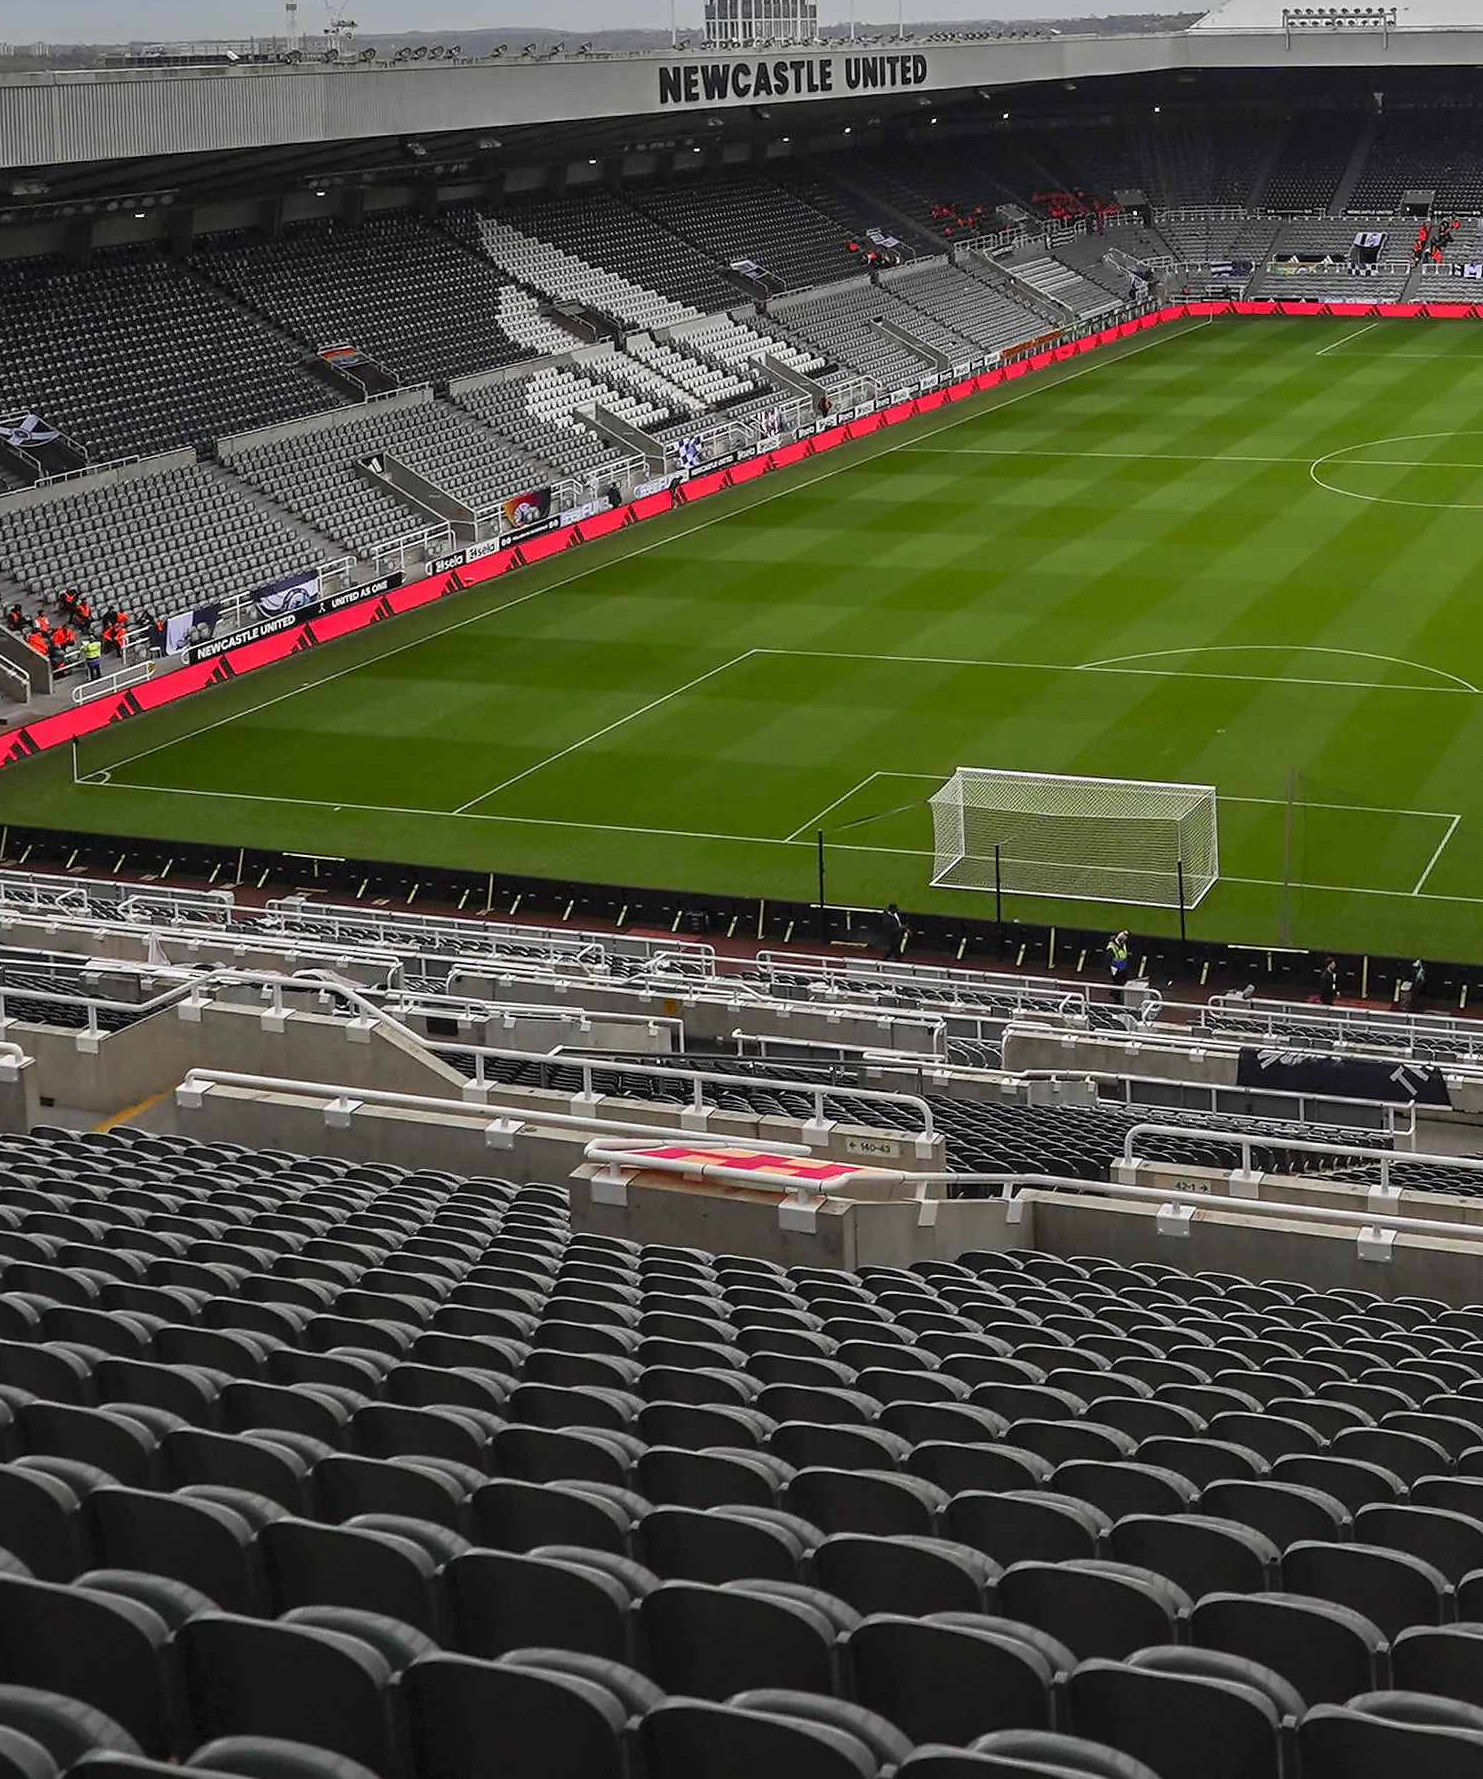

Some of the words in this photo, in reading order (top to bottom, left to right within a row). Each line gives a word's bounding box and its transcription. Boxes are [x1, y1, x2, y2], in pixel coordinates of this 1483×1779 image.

[659, 59, 833, 104] NEWCASTLE
[845, 54, 928, 89] UNITED
[331, 591, 360, 608] UNITED
[360, 587, 371, 599] AS
[371, 580, 389, 594] ONE
[197, 623, 259, 660] NEWCASTLE
[260, 614, 296, 636] UNITED
